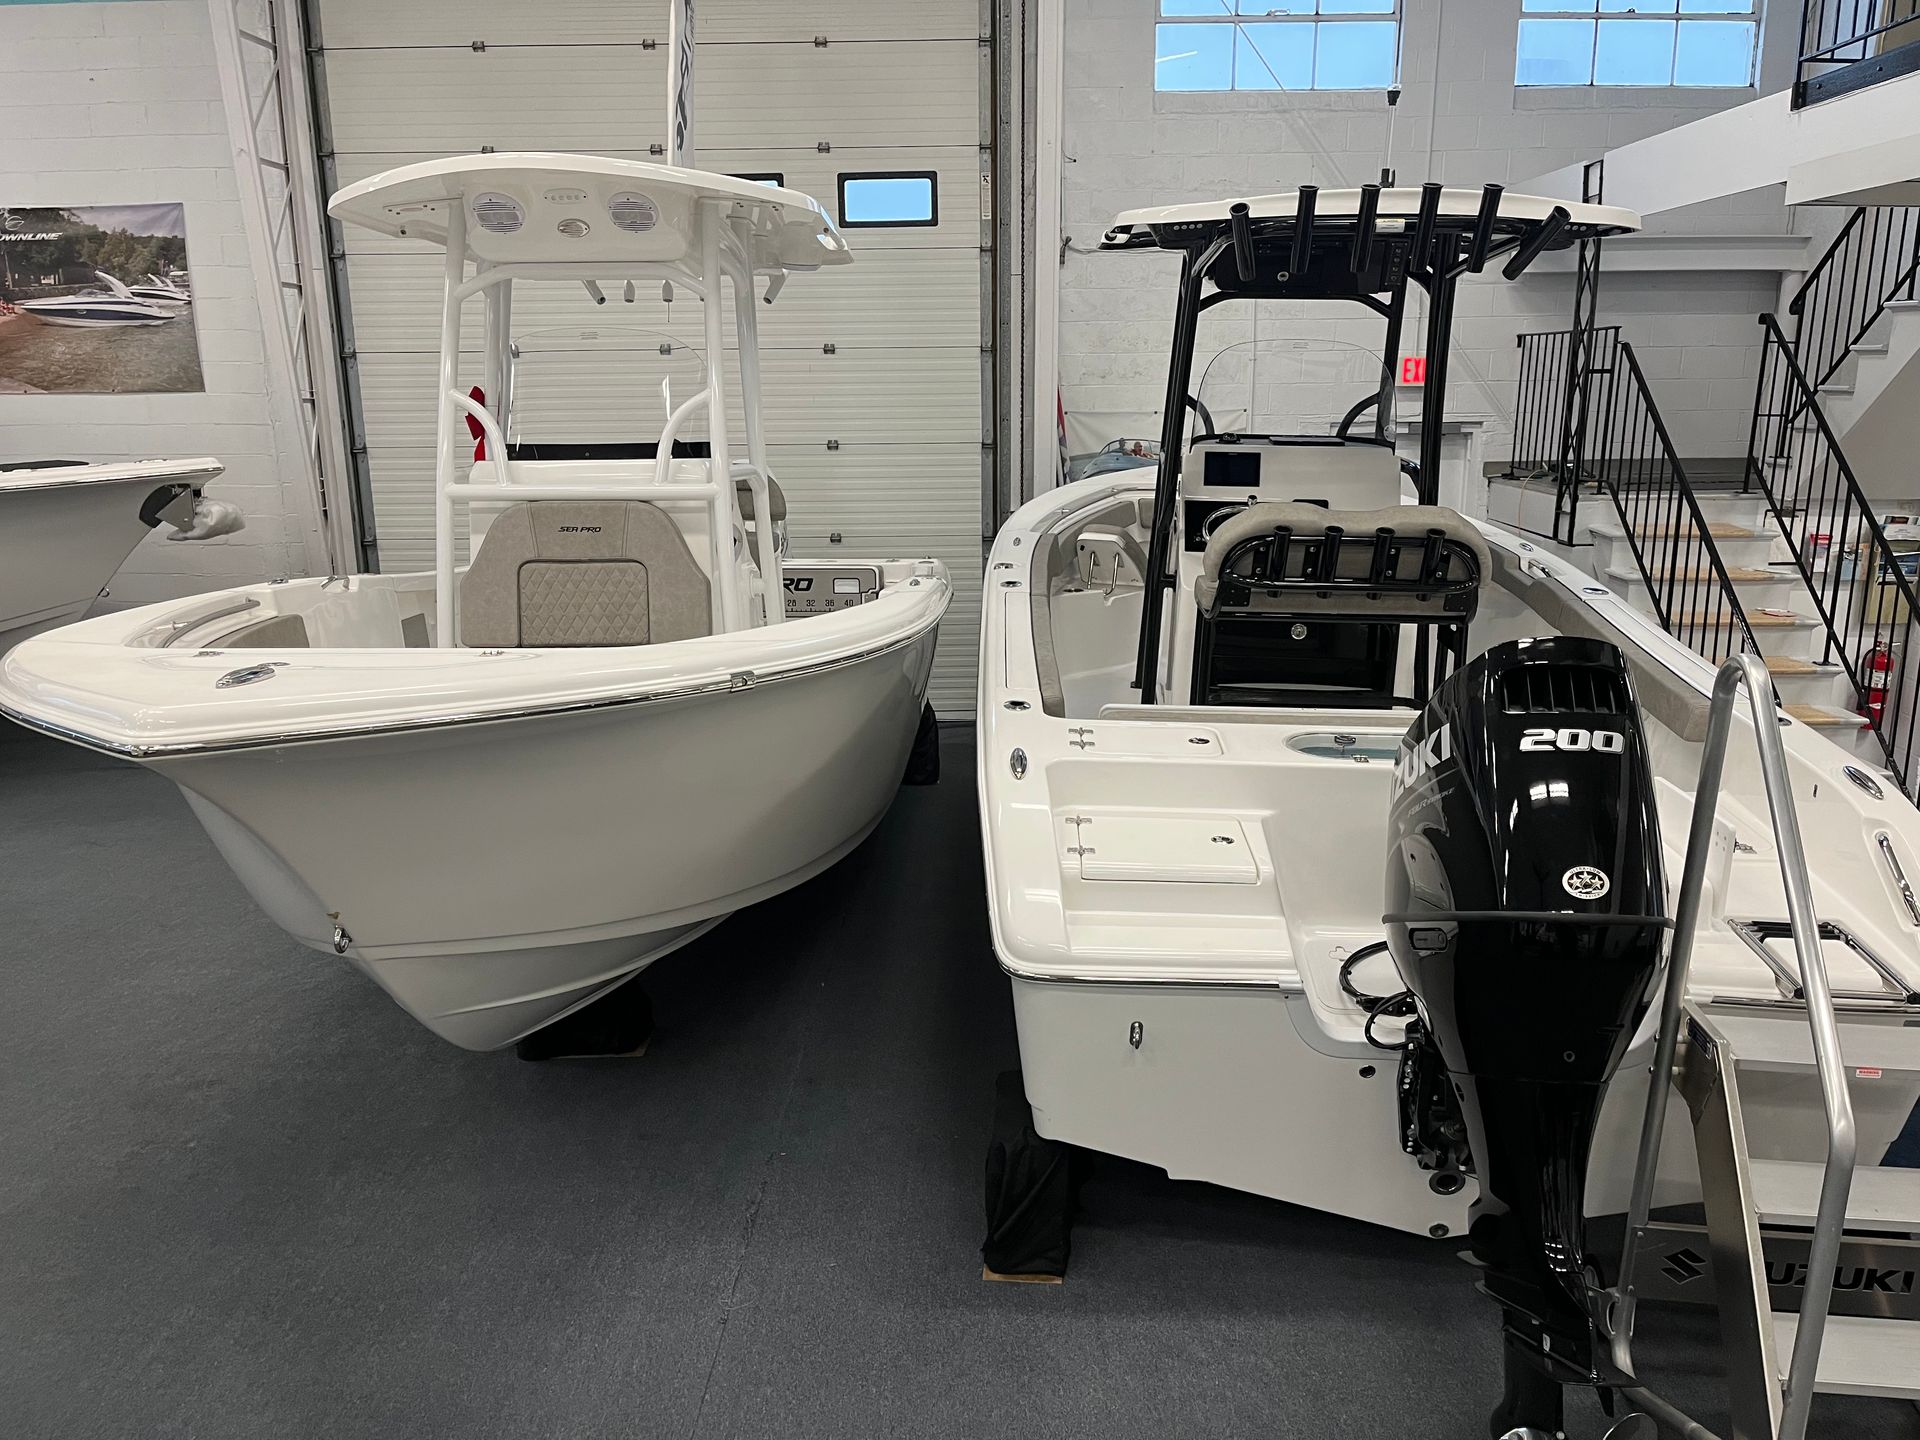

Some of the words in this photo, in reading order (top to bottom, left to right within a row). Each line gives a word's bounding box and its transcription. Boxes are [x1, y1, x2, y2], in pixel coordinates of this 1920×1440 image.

[0, 232, 63, 241] OWNLINE
[1402, 357, 1426, 384] EXI
[580, 526, 602, 534] PRO
[783, 578, 813, 594] RO
[806, 599, 816, 607] 32
[824, 599, 835, 607] 36
[844, 599, 854, 607] 40
[1519, 728, 1625, 754] 200
[1393, 722, 1451, 804] ZUKI
[1765, 1261, 1915, 1295] UUKI
